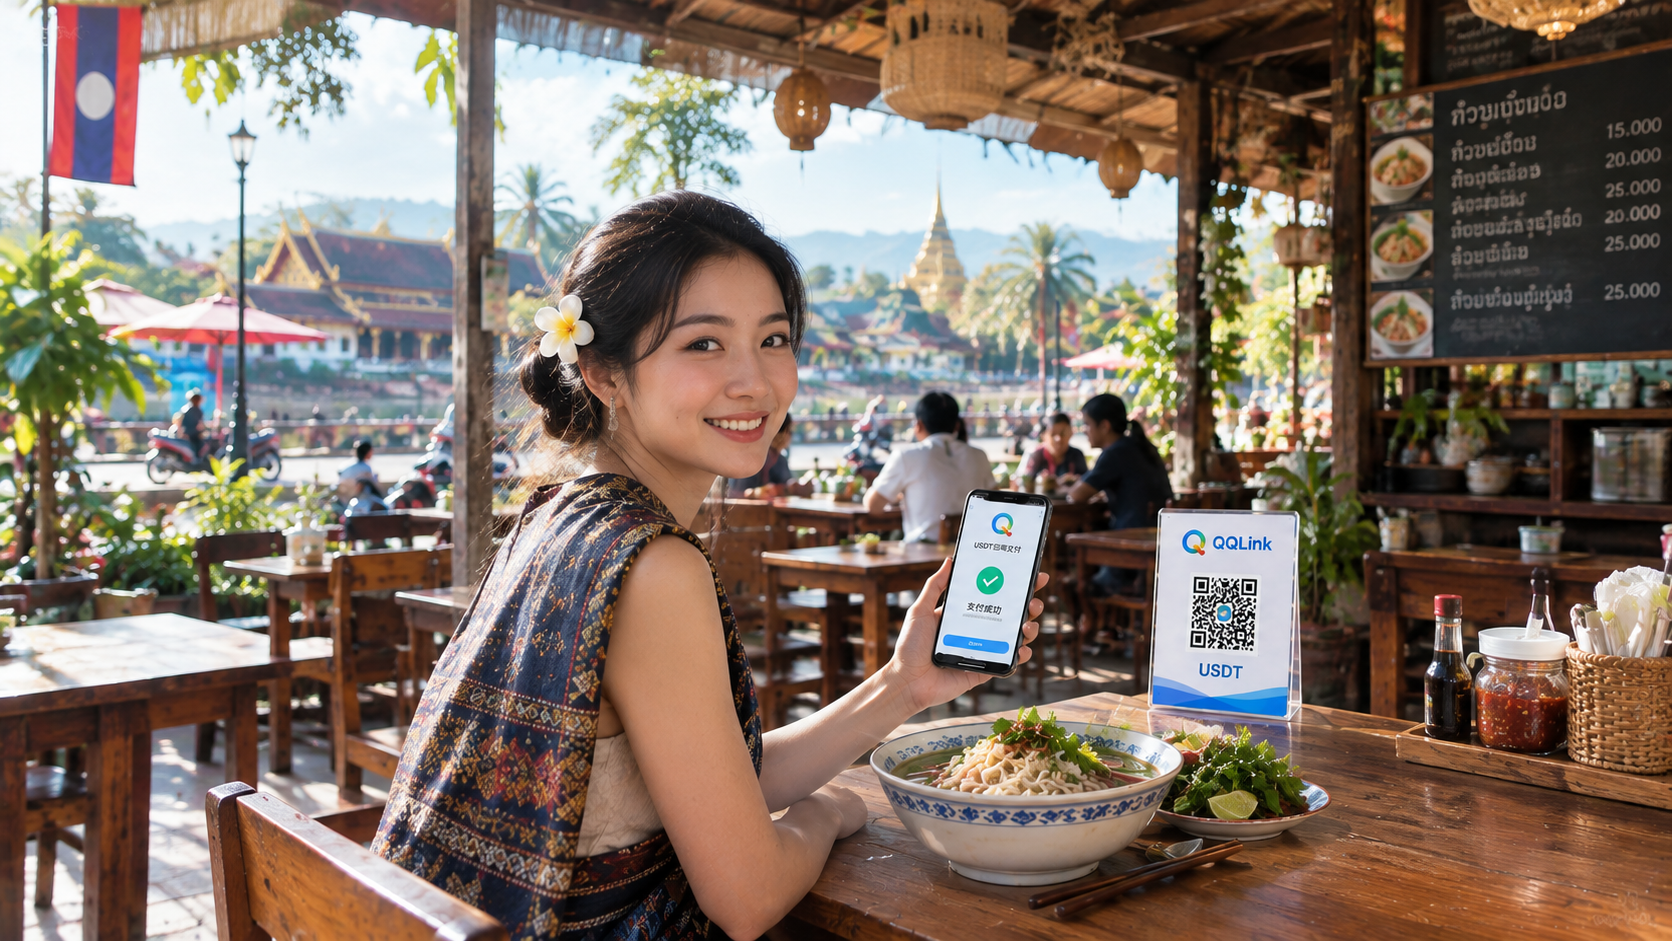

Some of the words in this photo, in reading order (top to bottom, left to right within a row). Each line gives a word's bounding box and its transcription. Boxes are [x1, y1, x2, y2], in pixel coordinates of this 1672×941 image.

[1607, 117, 1662, 139] 15.000
[1605, 147, 1662, 169] 20.000
[1605, 178, 1661, 198] 25.000
[1604, 203, 1661, 224] 20.000
[1604, 232, 1661, 252] 25.000
[1604, 282, 1661, 301] 25.000
[1212, 535, 1273, 551] QQLink
[1199, 663, 1243, 679] USDT
